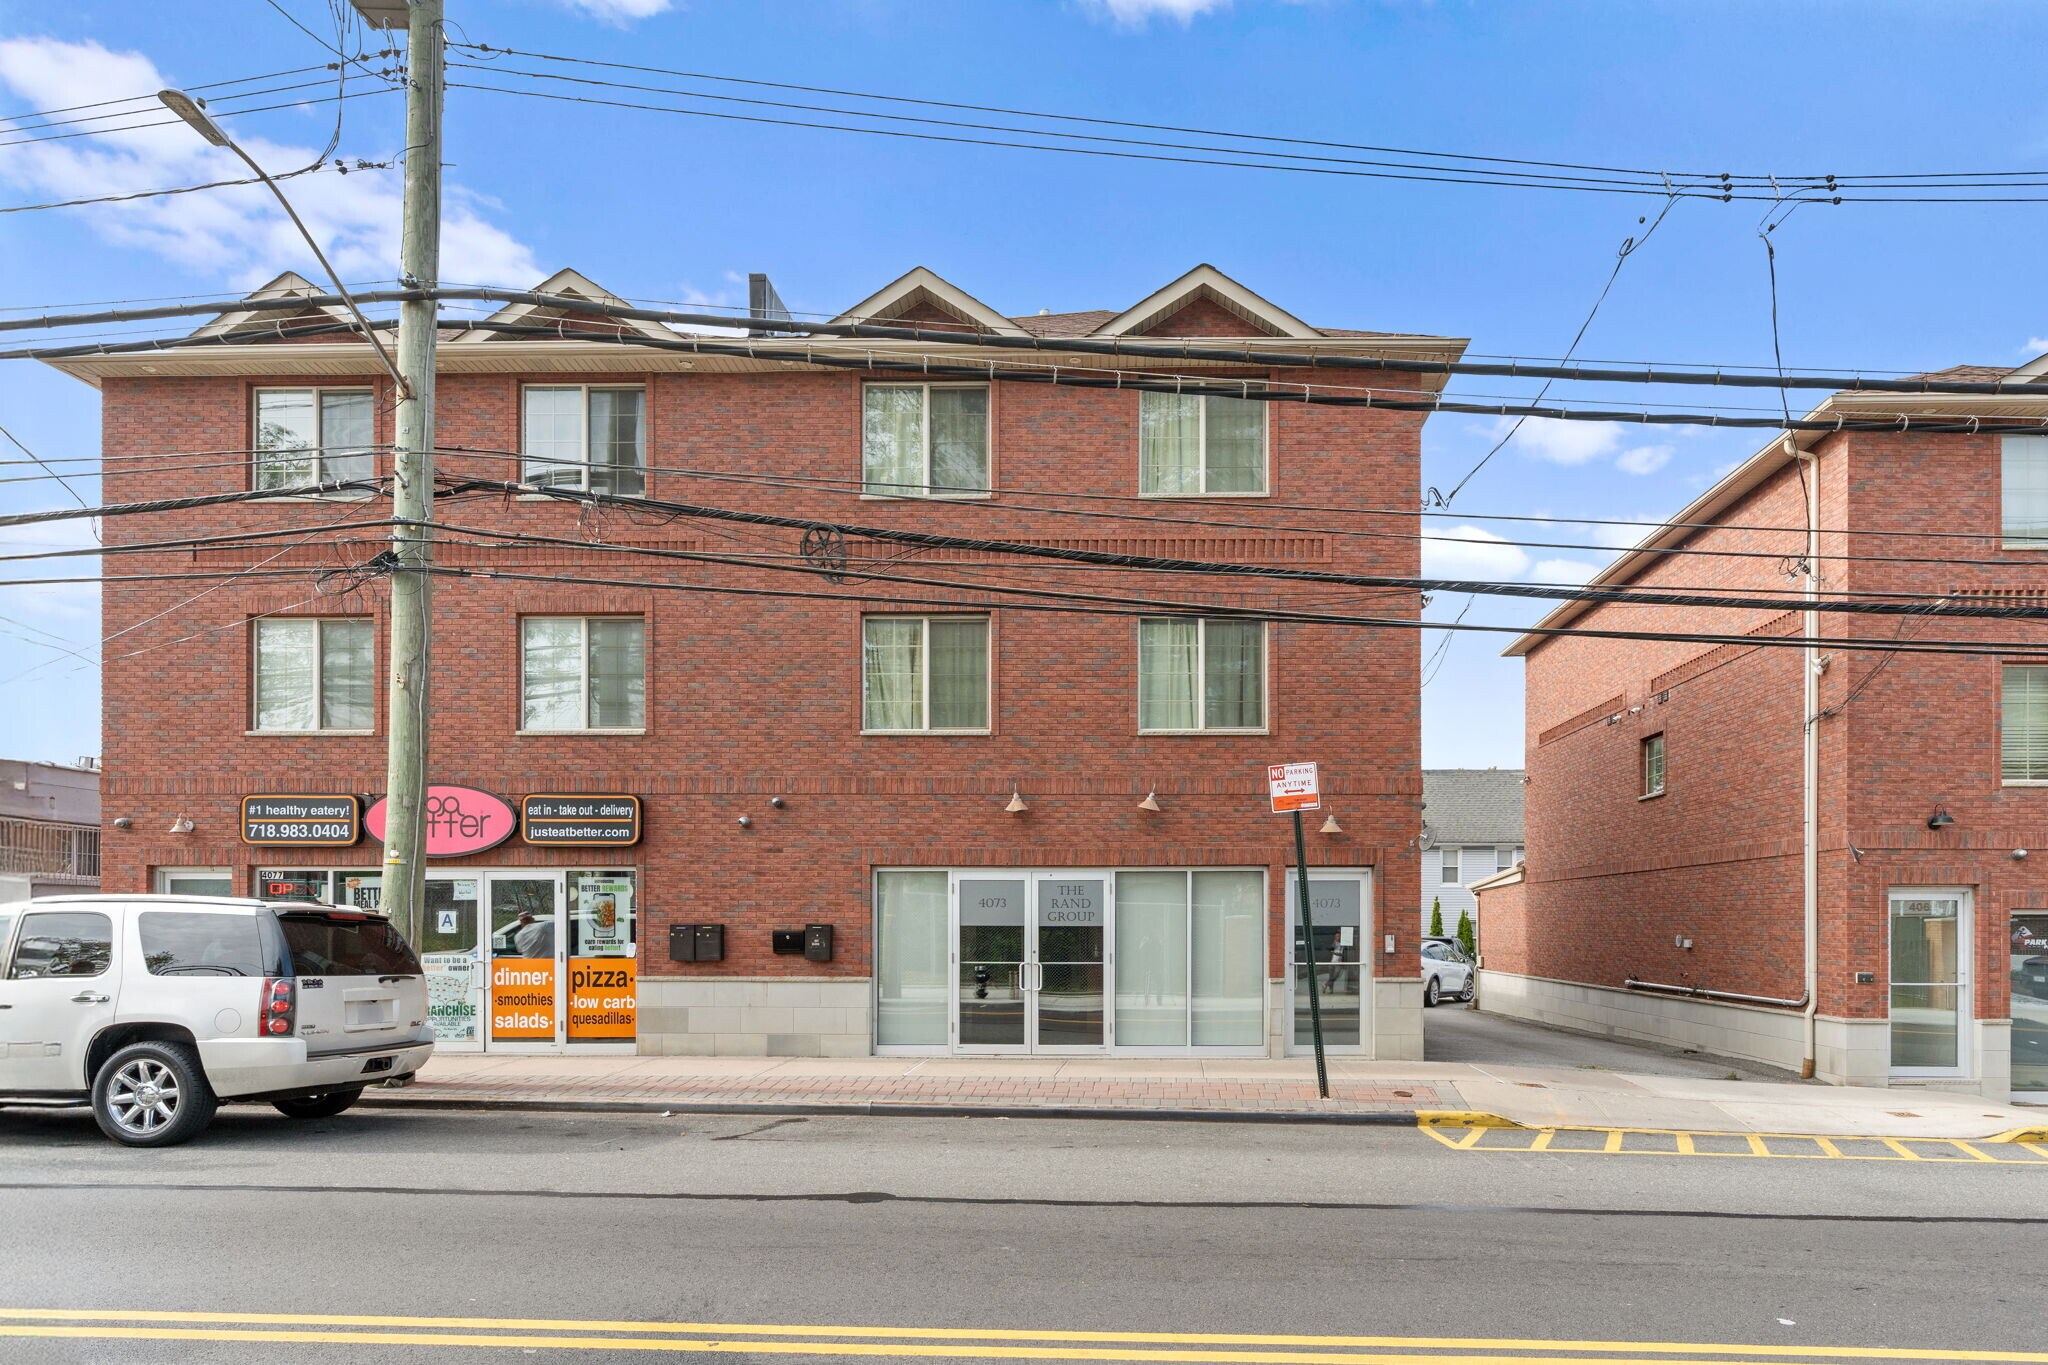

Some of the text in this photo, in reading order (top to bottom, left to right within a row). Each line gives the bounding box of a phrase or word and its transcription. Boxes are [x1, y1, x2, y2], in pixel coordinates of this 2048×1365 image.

[1271, 768, 1314, 779] NO PARKING
[1276, 780, 1312, 788] ANYTIME
[248, 805, 350, 818] #1 healthy eatery!
[528, 805, 541, 816] eat
[543, 804, 552, 816] in
[559, 805, 577, 816] take
[578, 805, 593, 816] out
[600, 804, 634, 818] delivery
[248, 824, 350, 838] 718.983.0404
[530, 827, 630, 839] justeatbetter.com
[269, 883, 317, 895] OPEN
[354, 887, 381, 900] BETT
[1057, 885, 1085, 896] THE
[978, 898, 1007, 908] 4073
[1051, 898, 1092, 909] RAND
[441, 913, 454, 928] A
[1047, 911, 1096, 922] GROUP
[603, 995, 636, 1009] carb
[428, 1004, 476, 1016] ANCHISE
